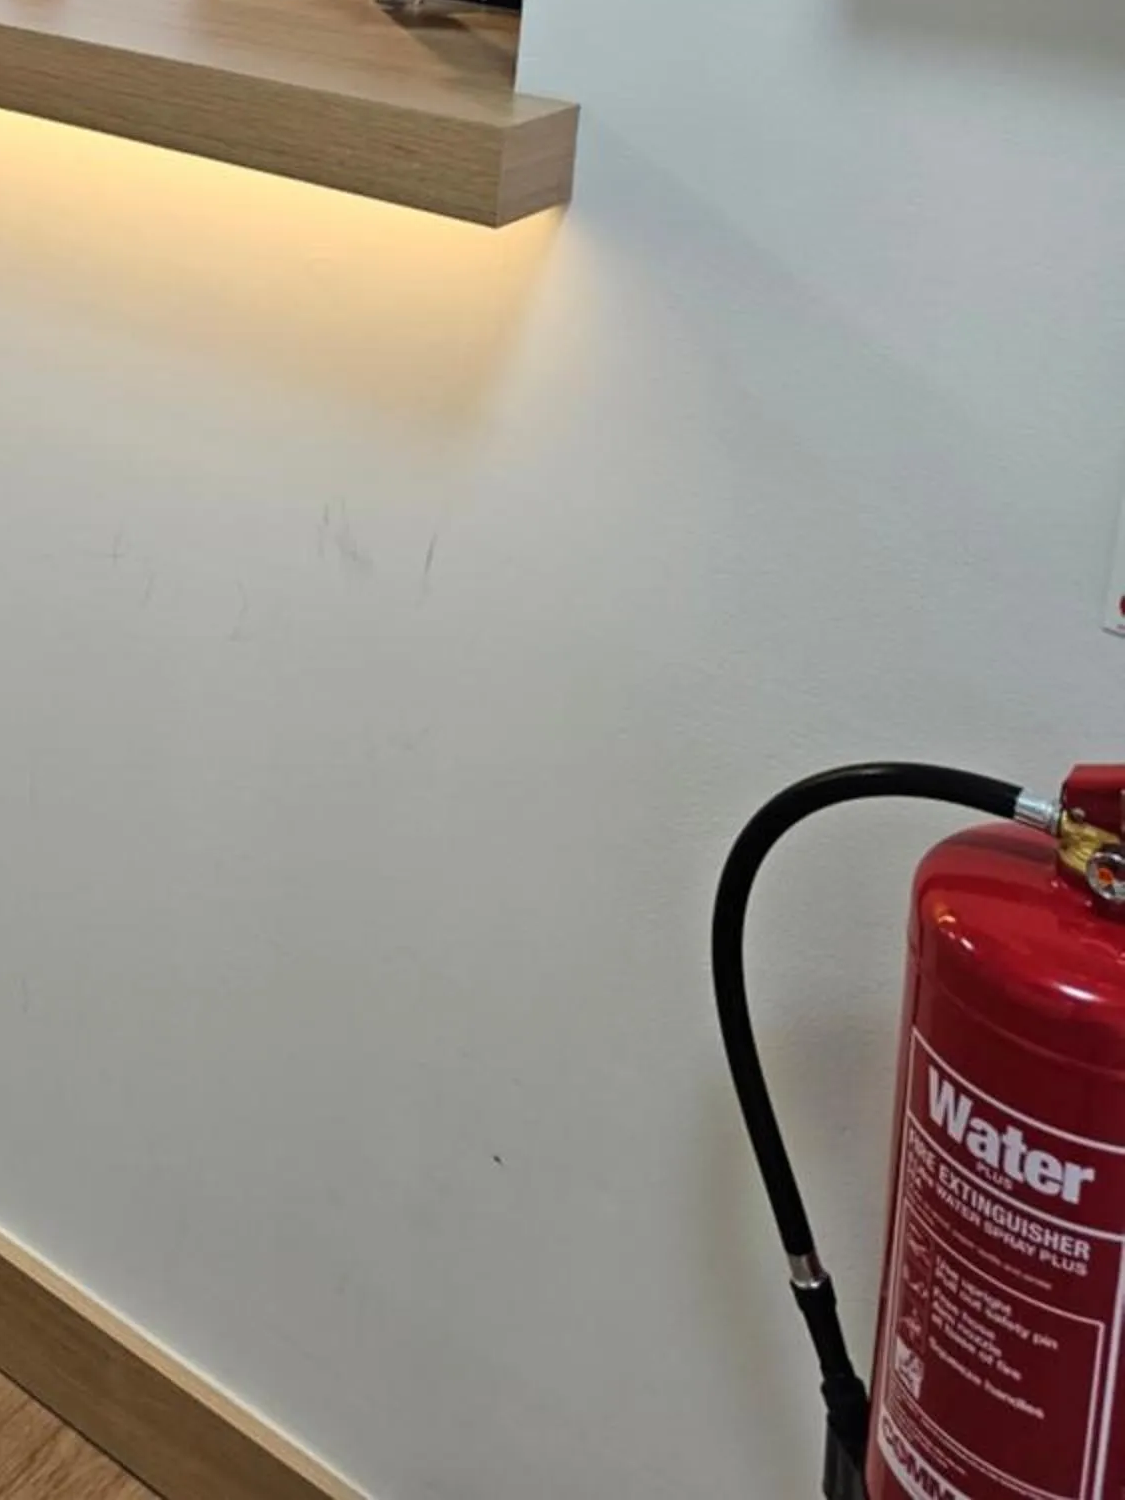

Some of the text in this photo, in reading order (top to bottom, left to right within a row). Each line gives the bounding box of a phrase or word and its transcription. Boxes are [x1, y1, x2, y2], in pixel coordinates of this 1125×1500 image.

[928, 1064, 1096, 1205] Water
[976, 1162, 1013, 1190] PLUS
[936, 1182, 981, 1227] WATER
[982, 1220, 1037, 1257] SPRAY
[1039, 1250, 1088, 1277] PLUS
[938, 1164, 1091, 1261] EXTINGUISHER
[1032, 1332, 1059, 1351] pin
